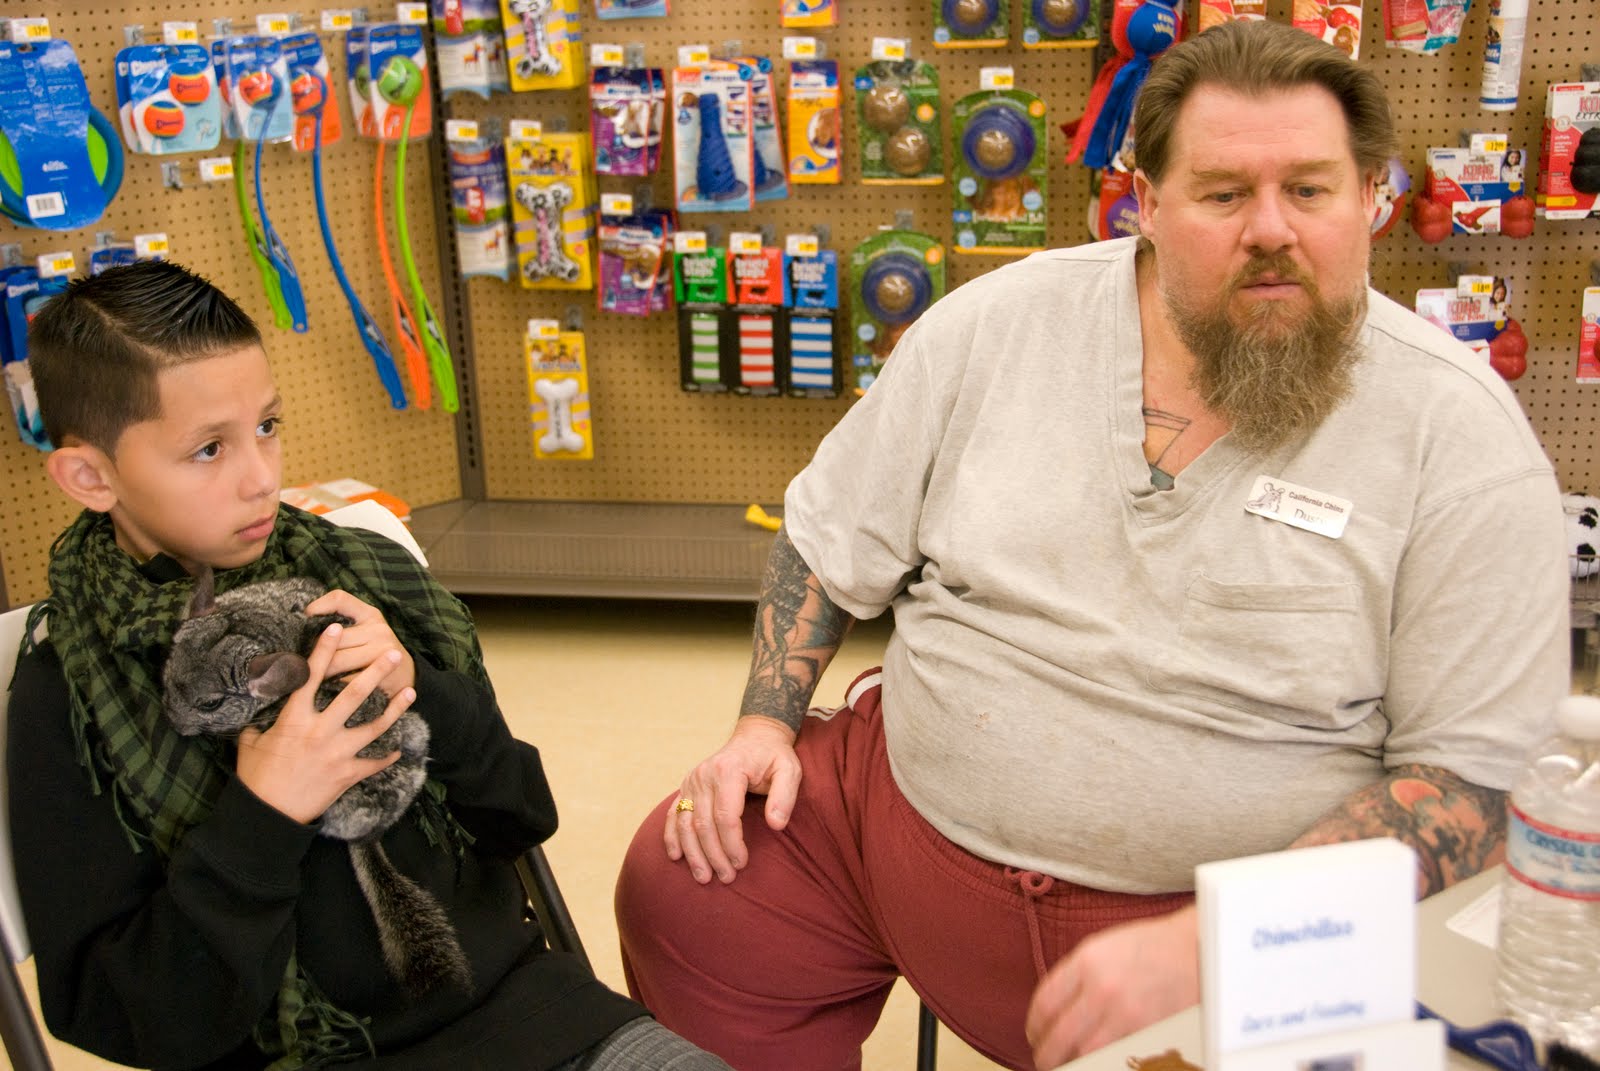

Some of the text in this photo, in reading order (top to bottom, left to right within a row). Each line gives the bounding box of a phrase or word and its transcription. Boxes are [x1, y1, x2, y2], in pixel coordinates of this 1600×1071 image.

[1463, 164, 1494, 176] KONG
[1288, 491, 1345, 514] California Chins
[1525, 828, 1585, 858] CRYSTAL
[1252, 916, 1354, 950] Chinchillas
